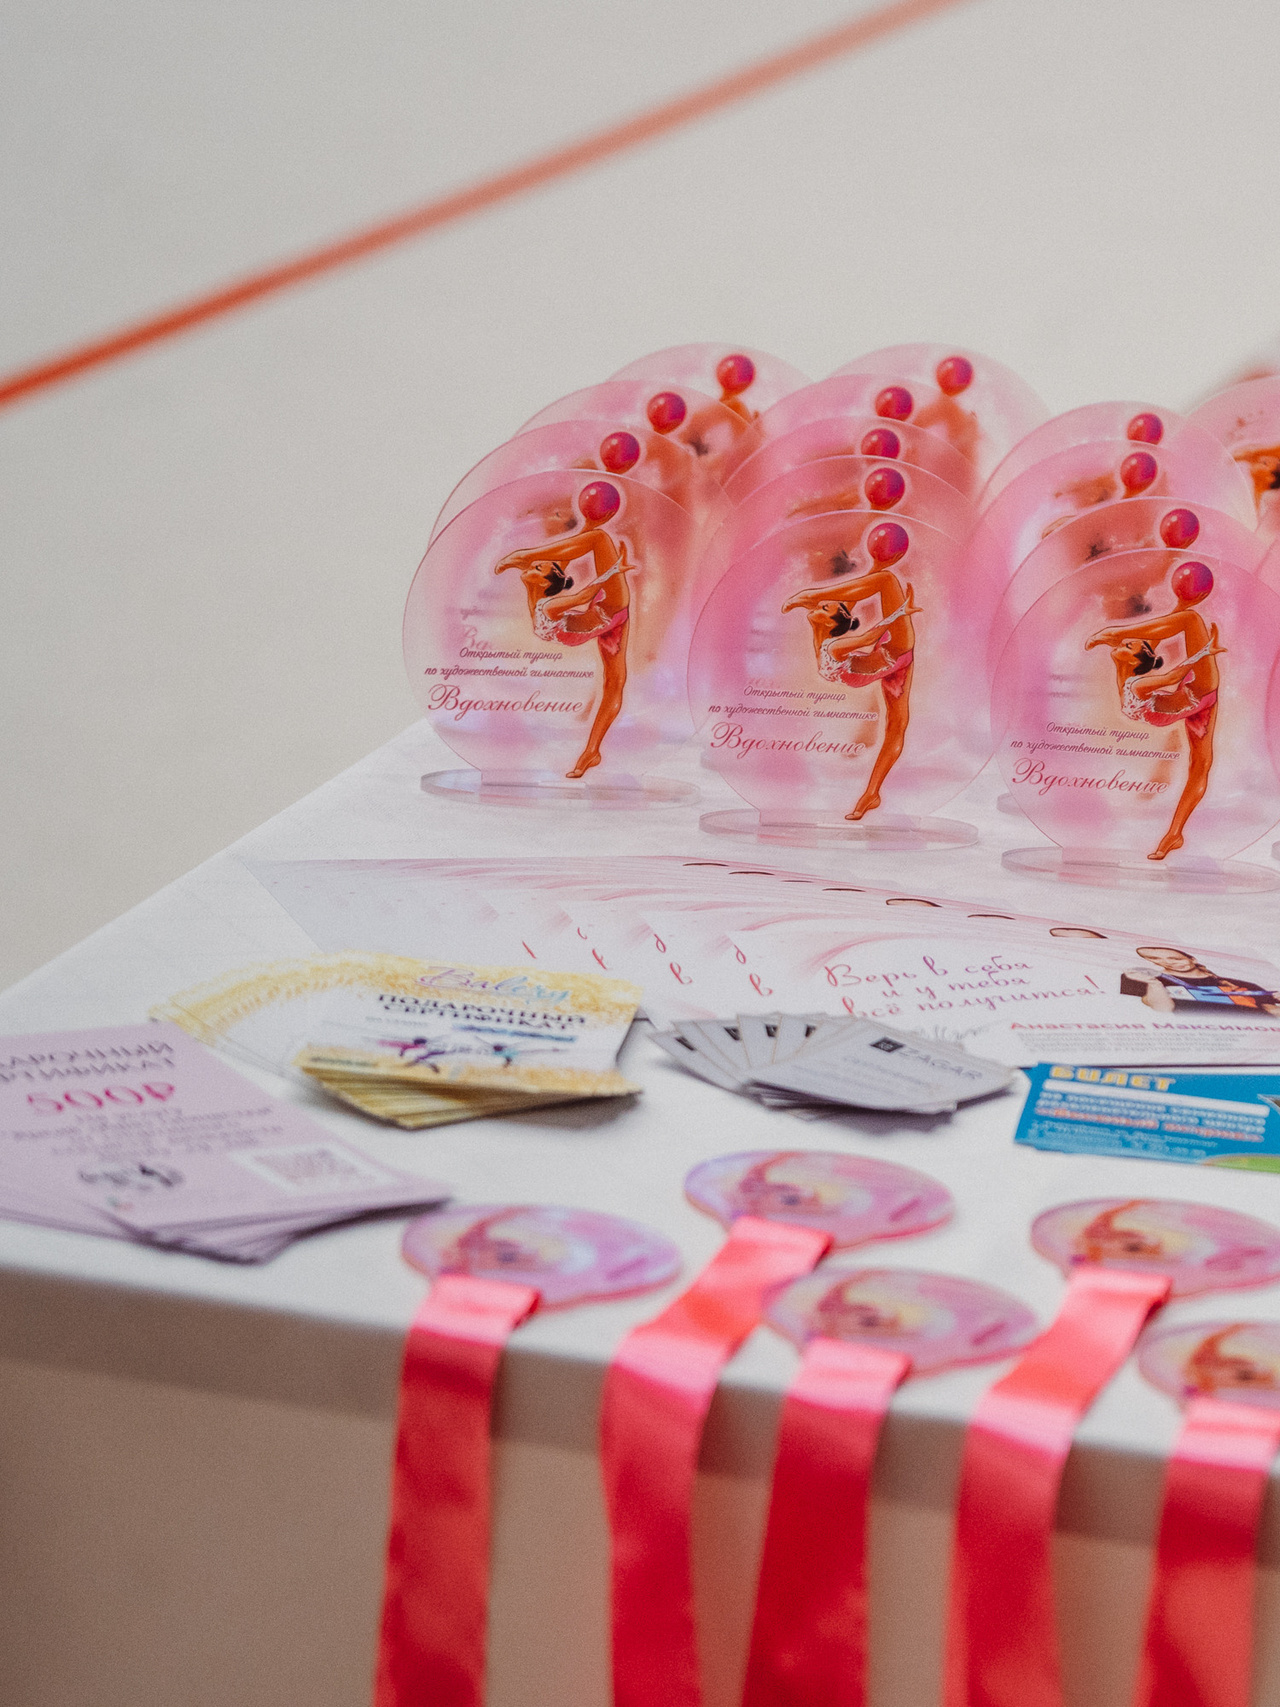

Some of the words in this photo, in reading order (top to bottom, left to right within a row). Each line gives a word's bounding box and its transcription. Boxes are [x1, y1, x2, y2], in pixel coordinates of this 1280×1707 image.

[459, 647, 521, 660] Открытый
[523, 651, 563, 664] турнир
[424, 666, 438, 676] по
[440, 664, 528, 680] художественной
[530, 670, 595, 679] гимнастике
[427, 683, 584, 721] Вдохновение
[743, 685, 804, 699] Открытый
[806, 691, 847, 704] турнир
[708, 704, 722, 713] по
[724, 703, 810, 718] художественной
[813, 710, 878, 720] гимнастике
[710, 721, 866, 760] Вдохновение
[1046, 722, 1107, 737] Открытый
[1109, 730, 1150, 743] турнир
[1010, 739, 1024, 748] по
[1025, 739, 1113, 754] художественной
[1116, 748, 1181, 760] гимнастике
[1012, 757, 1170, 796] Вдохновение
[823, 963, 917, 987] Верь
[922, 955, 948, 976] в
[964, 955, 1032, 974] себя
[881, 988, 903, 998] и
[915, 985, 937, 1000] у
[948, 970, 1031, 992] тебя
[918, 975, 1106, 1012] получится!
[378, 993, 586, 1024] ПОДАРОЧНЫЙ
[383, 1005, 568, 1030] СЕРТИФИКАТ
[1011, 1022, 1146, 1031] Анастасия
[0, 1040, 174, 1069] АРОЧНЫЙ
[1050, 1065, 1176, 1091] БИЛЕТ
